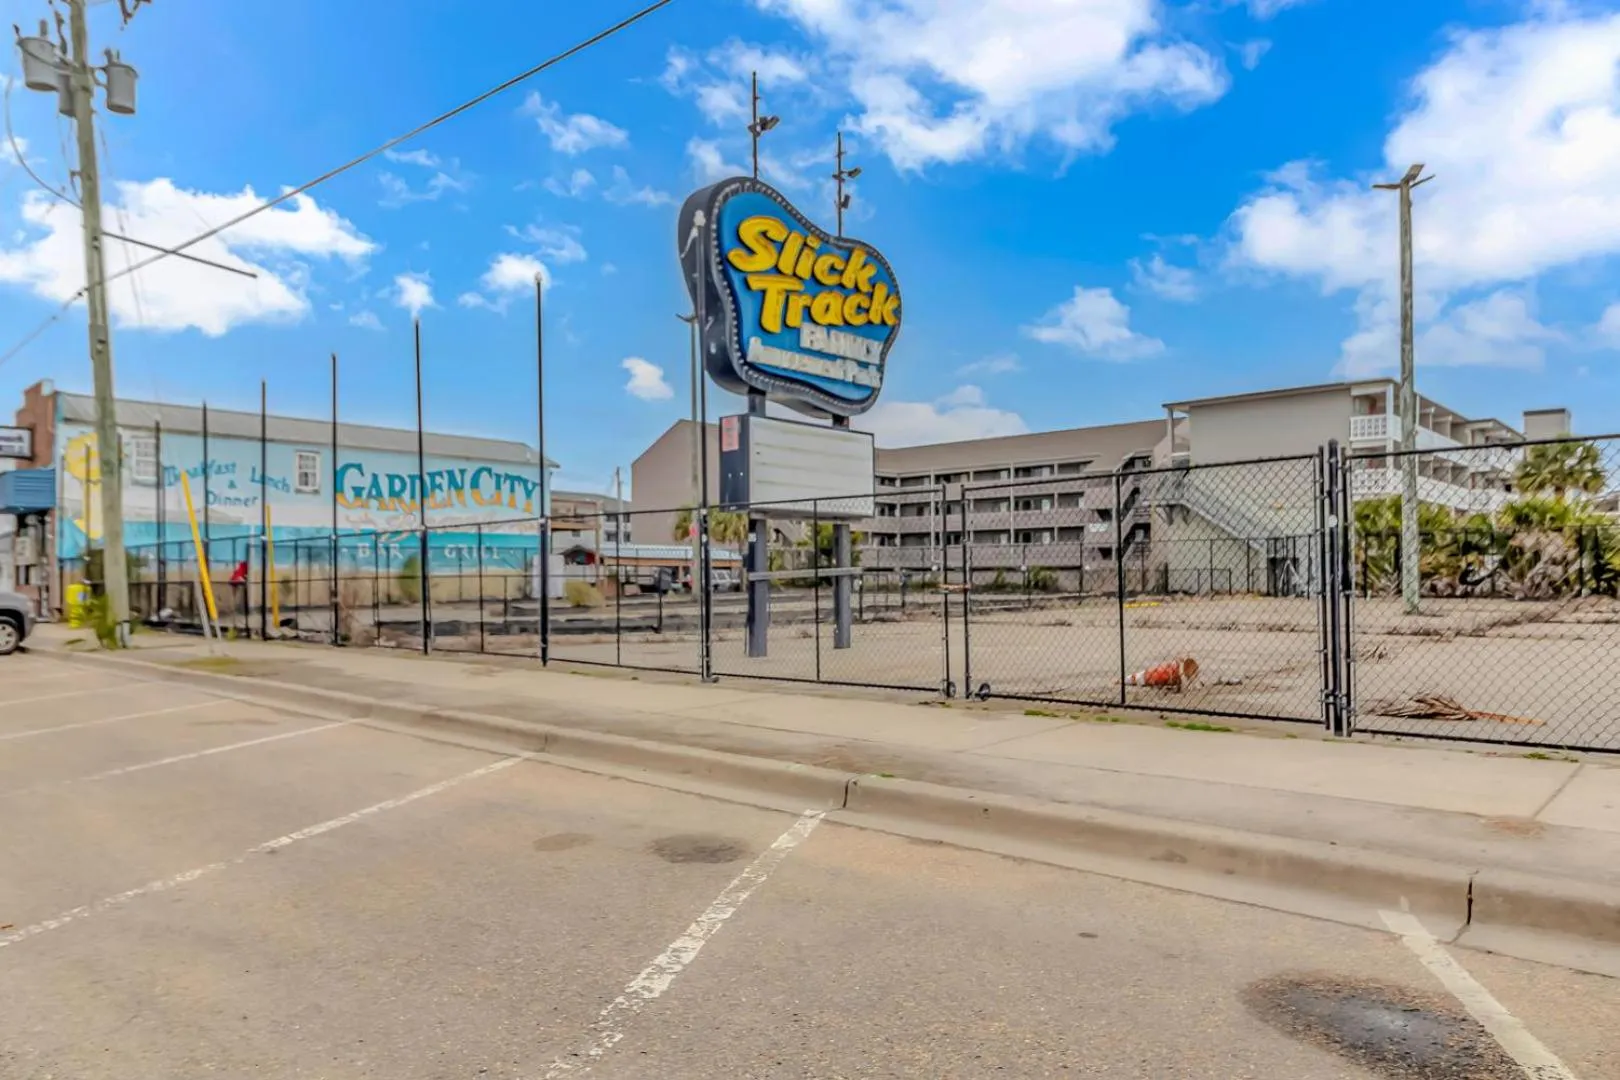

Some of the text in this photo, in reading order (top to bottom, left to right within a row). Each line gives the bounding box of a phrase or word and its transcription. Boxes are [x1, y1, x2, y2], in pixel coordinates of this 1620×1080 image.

[727, 215, 878, 293] Slick
[747, 274, 902, 334] Track
[249, 465, 291, 494] Lnch
[335, 462, 541, 515] GARDEN CITY
